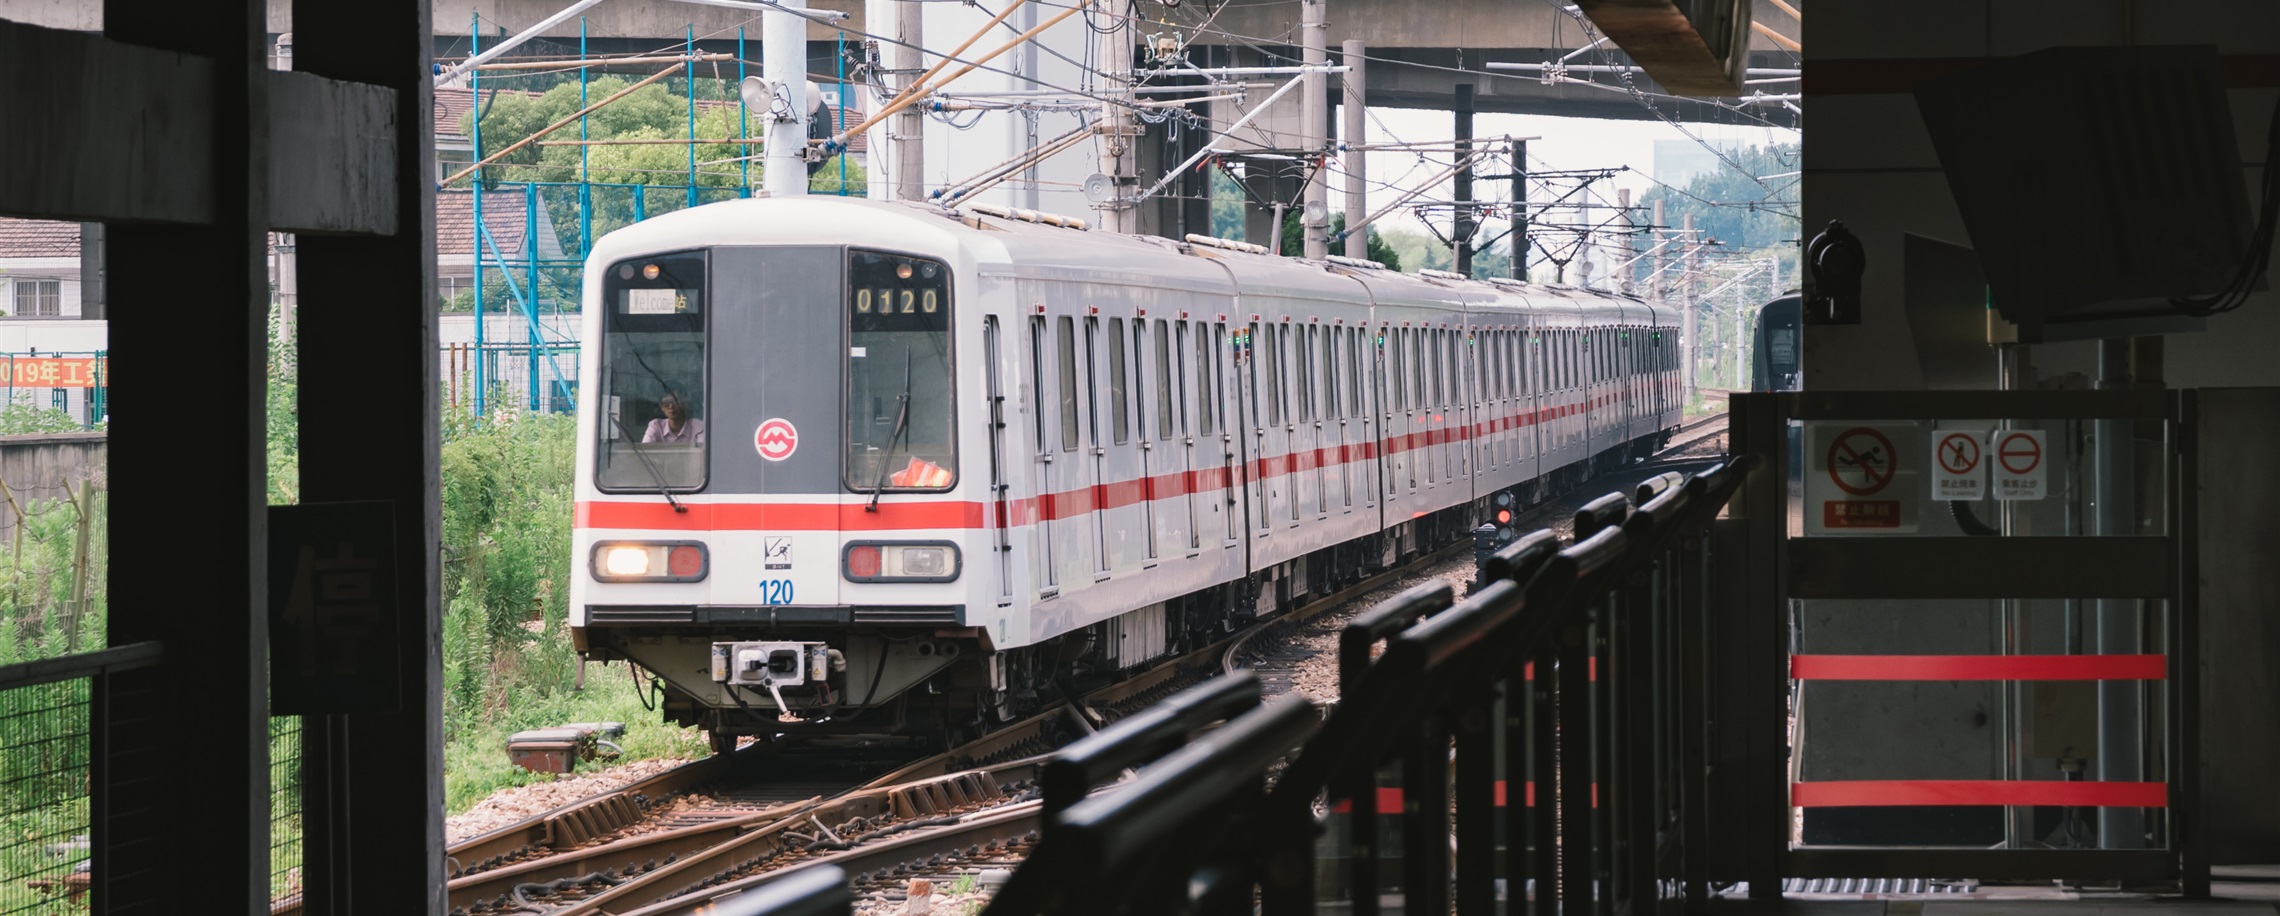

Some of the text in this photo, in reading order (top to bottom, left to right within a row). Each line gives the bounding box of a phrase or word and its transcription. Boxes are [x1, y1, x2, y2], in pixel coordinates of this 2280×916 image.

[857, 288, 937, 314] 0120
[759, 579, 794, 605] 120
[281, 540, 379, 677] 停
